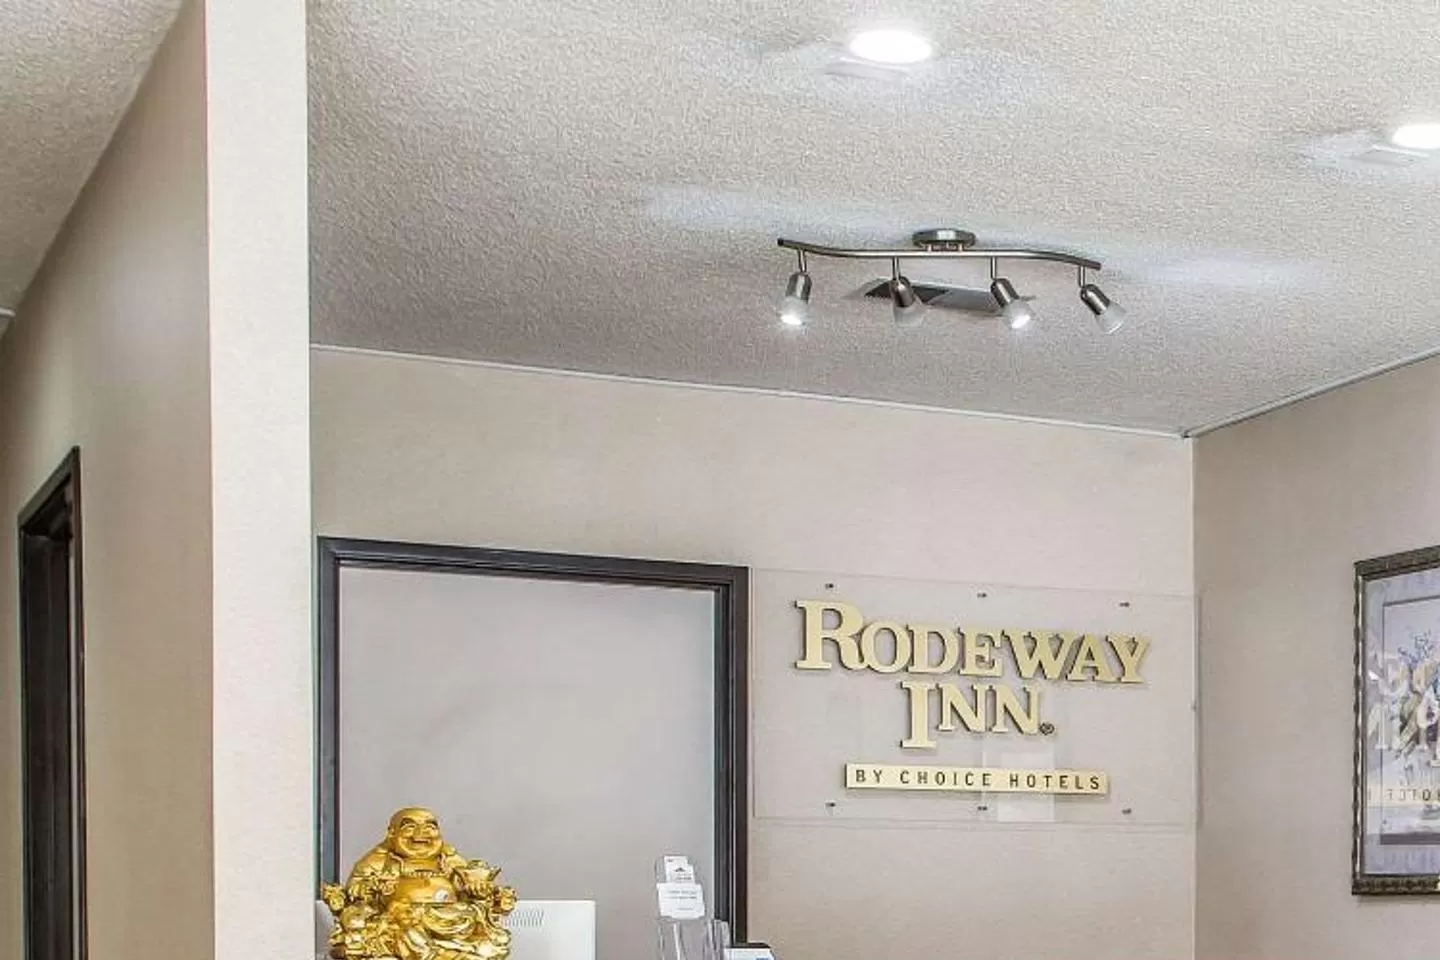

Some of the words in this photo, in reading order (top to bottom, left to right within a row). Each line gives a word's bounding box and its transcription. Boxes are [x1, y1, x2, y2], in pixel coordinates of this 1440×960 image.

[794, 600, 1151, 684] RODEWAY
[900, 680, 1043, 749] INN
[855, 768, 884, 784] BY
[899, 770, 992, 787] CHOICE
[1008, 773, 1102, 791] HOTELS
